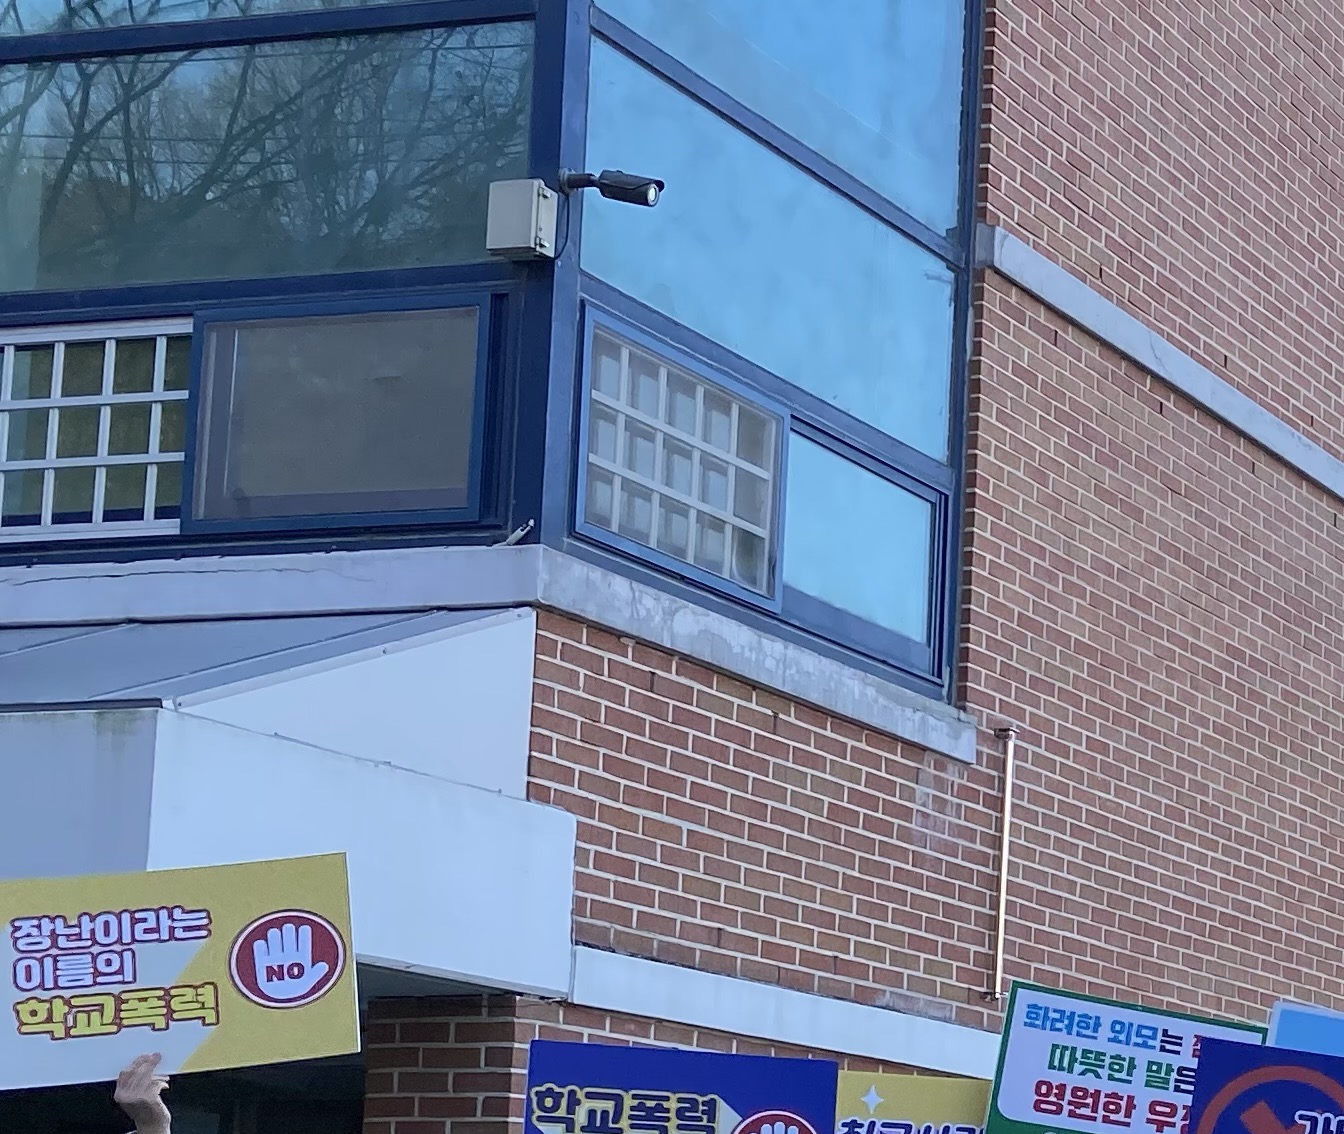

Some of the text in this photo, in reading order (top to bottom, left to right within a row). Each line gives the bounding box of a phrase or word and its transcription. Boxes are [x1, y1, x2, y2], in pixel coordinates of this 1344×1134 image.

[11, 905, 212, 954] 장난이라는
[13, 949, 136, 992] 이름의
[265, 962, 305, 983] NO
[15, 982, 219, 1041] 학교폭력
[1024, 1002, 1103, 1040] 화려한
[1107, 1018, 1183, 1056] 외모는
[1048, 1042, 1137, 1084] 따뜻한
[1033, 1079, 1137, 1129] 영원한
